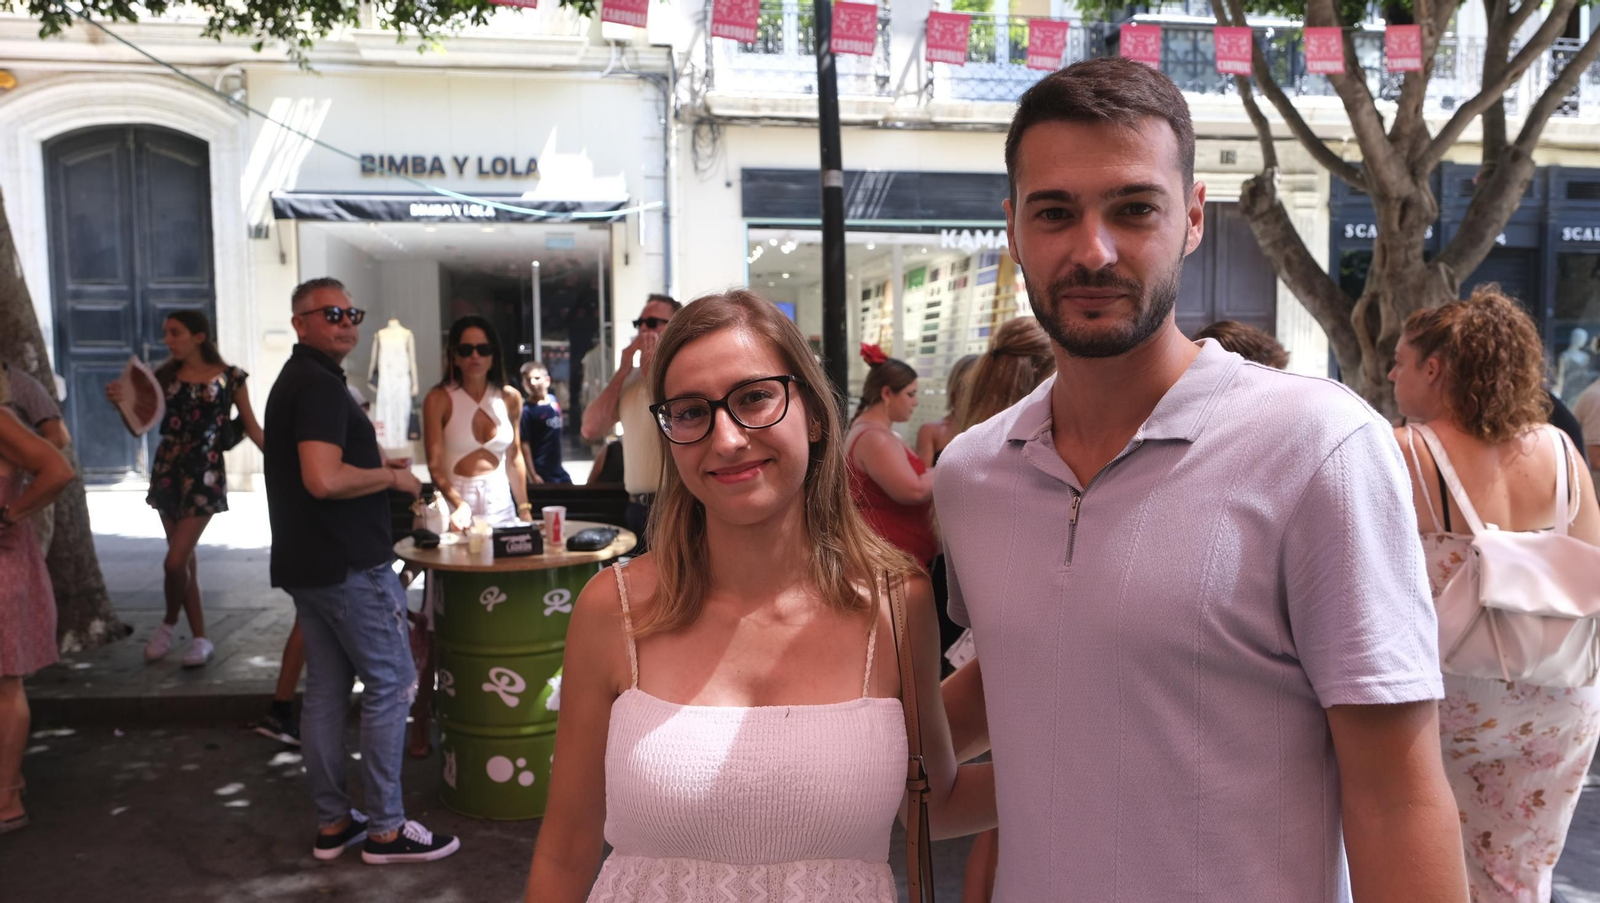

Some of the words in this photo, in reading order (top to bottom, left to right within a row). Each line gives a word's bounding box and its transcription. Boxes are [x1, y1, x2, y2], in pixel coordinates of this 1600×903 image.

[361, 154, 446, 176] BIMBA
[453, 155, 470, 175] Y
[478, 156, 539, 176] LOLA
[410, 203, 451, 216] BIMBA
[451, 203, 462, 216] Y
[464, 203, 496, 217] LOLA
